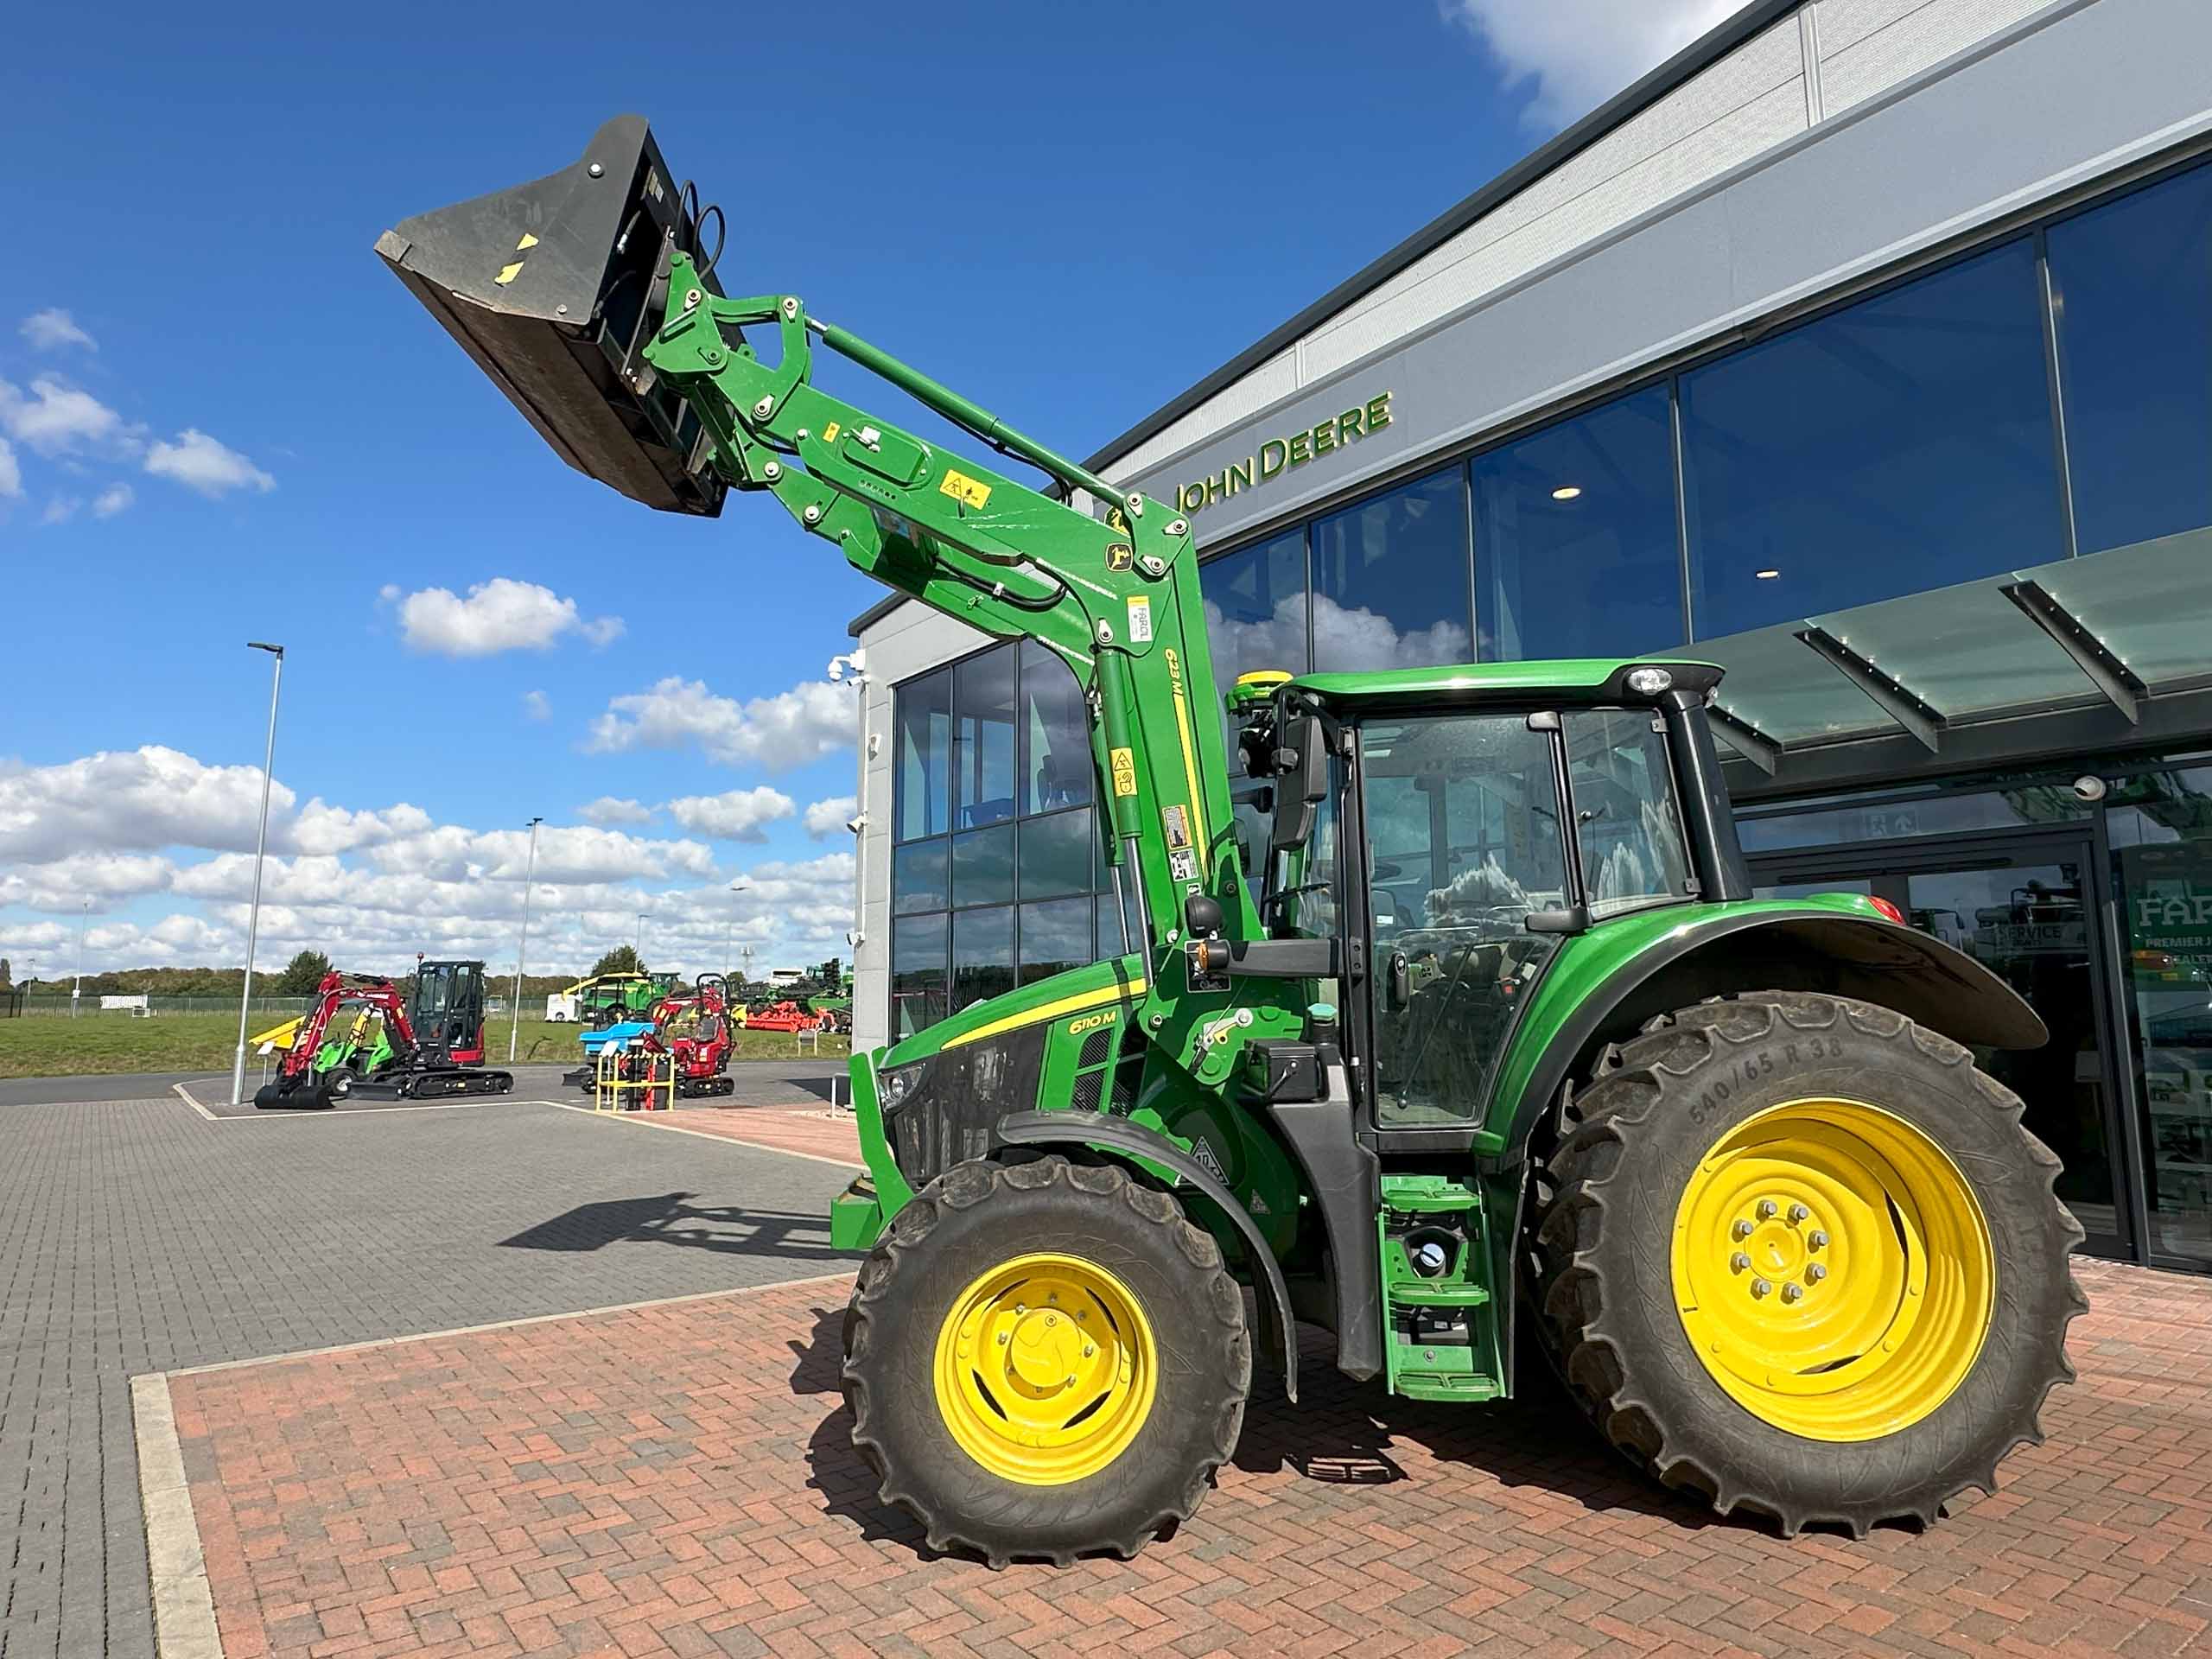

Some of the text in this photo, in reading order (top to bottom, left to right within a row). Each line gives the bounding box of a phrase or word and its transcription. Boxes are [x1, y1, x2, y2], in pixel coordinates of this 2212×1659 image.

[1176, 391, 1394, 513] JOHN DEERE
[1998, 925, 2062, 940] SERVICE
[2145, 936, 2203, 948] PREMIER
